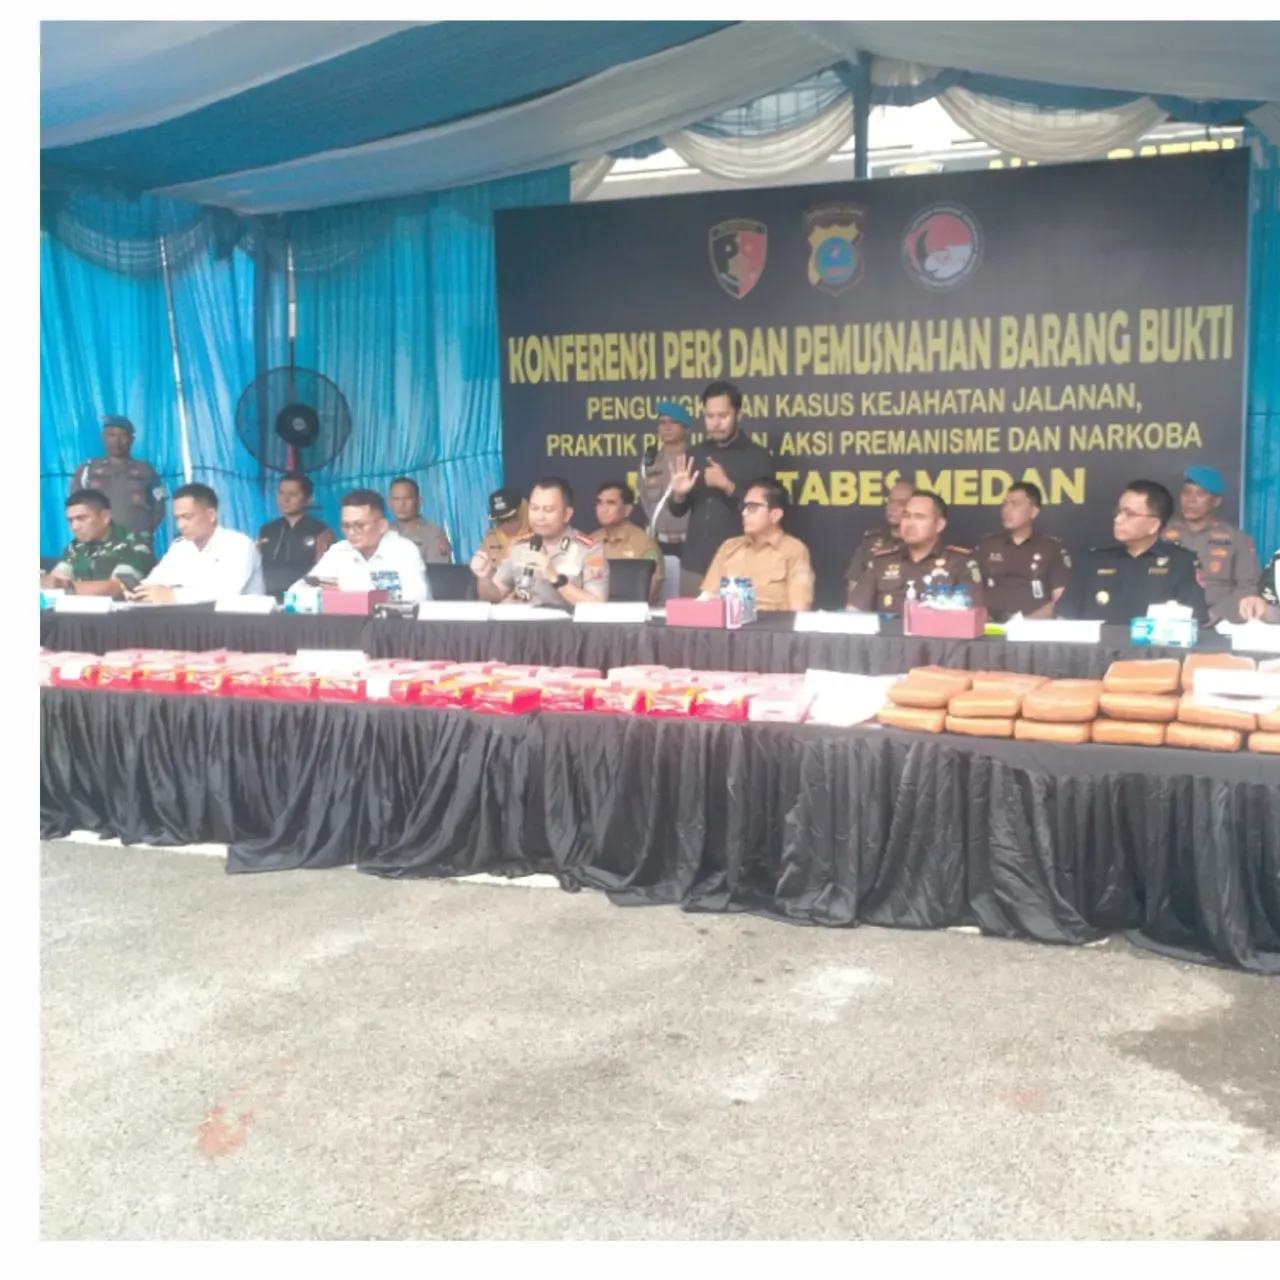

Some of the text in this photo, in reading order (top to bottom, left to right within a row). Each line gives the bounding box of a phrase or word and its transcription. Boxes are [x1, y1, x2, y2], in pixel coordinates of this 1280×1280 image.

[508, 304, 1234, 385] KONFERENSI PERS DAN PEMUSNAHAN BARANG BUKTI
[776, 392, 854, 418] KASUS
[861, 387, 1005, 416] KEJAHATAN
[1012, 382, 1142, 414] JALANAN,
[547, 433, 637, 457] PRAKTIK
[780, 430, 834, 456] AKSI
[840, 426, 1001, 456] PREMANISME
[1008, 425, 1061, 453] DAN
[1069, 421, 1203, 452] NARKOBA
[915, 467, 1086, 506] MEDAN
